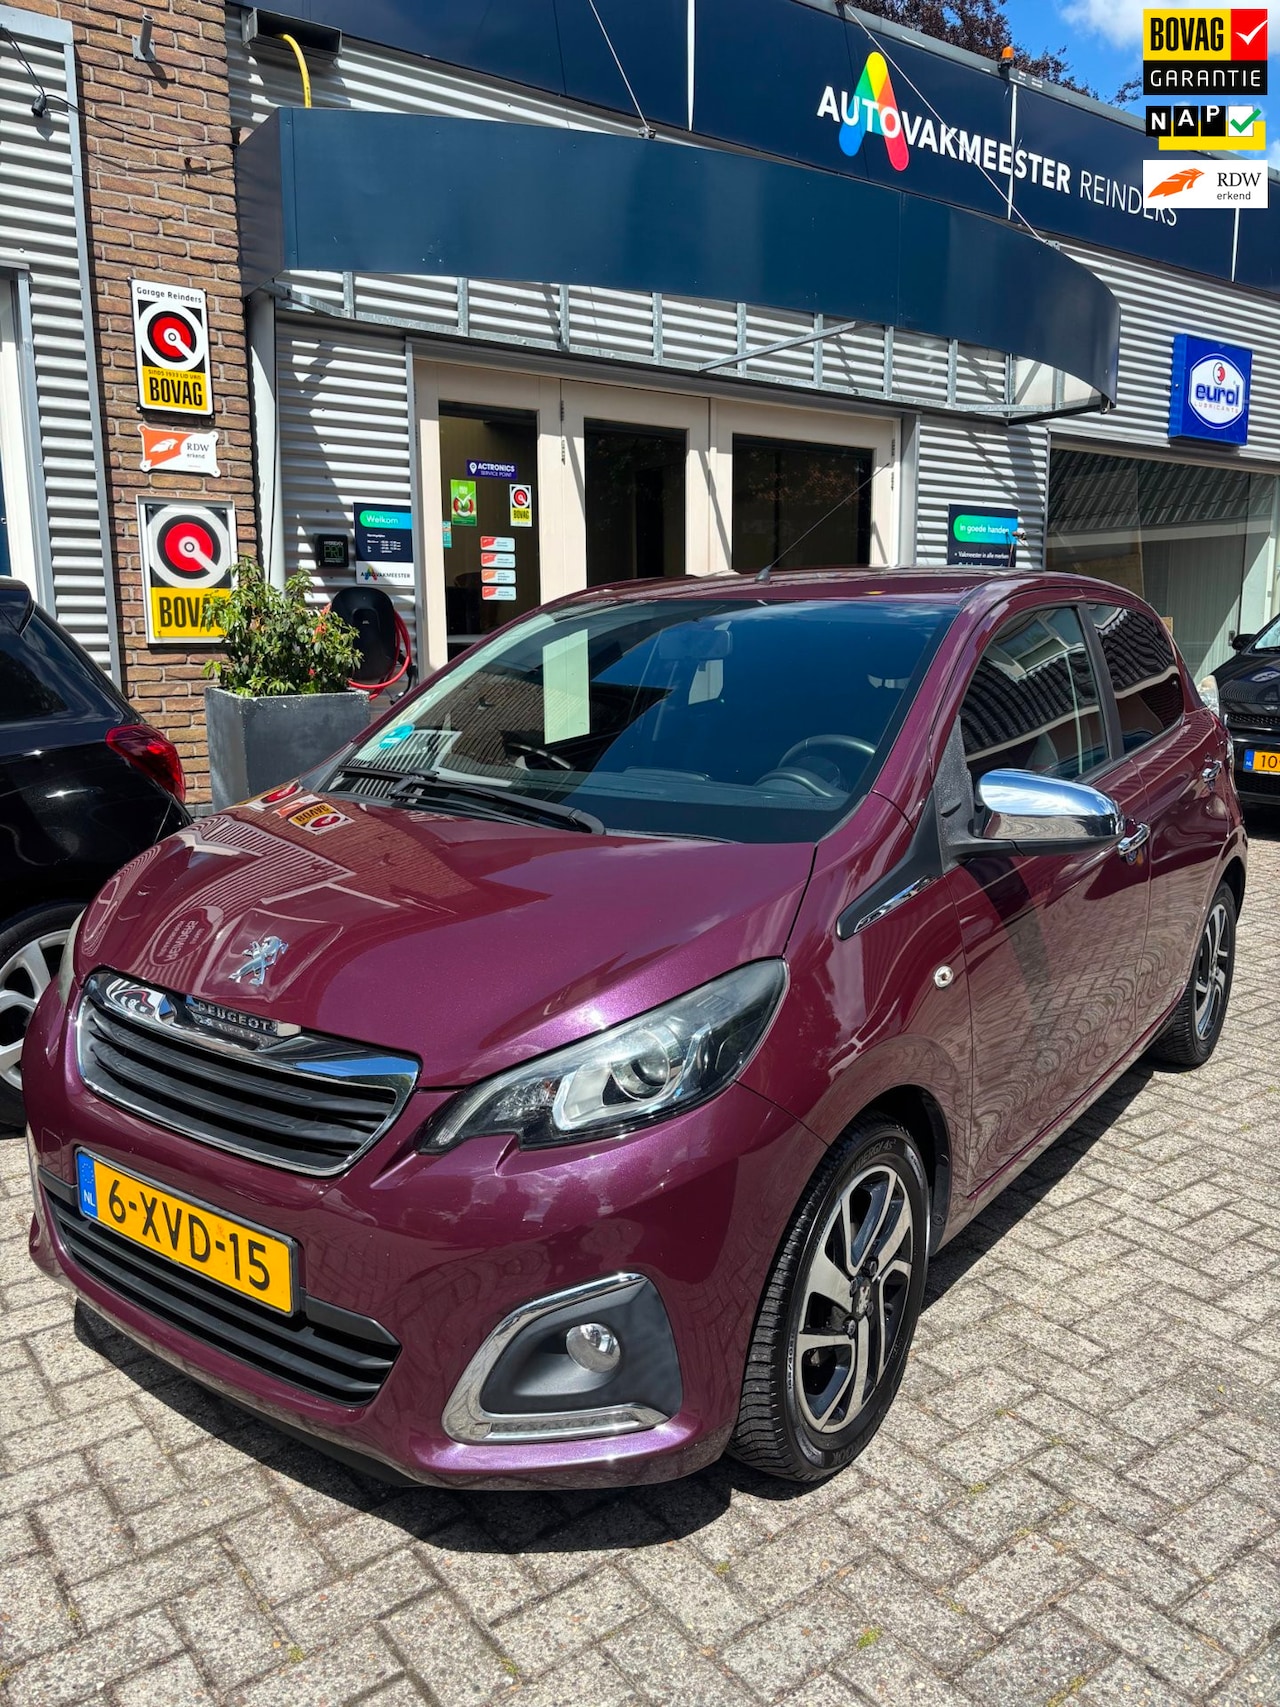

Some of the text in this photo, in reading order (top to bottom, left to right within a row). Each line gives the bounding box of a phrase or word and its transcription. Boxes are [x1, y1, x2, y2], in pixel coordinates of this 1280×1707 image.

[816, 85, 1071, 194] AUTOVAKMEESTER
[136, 286, 202, 303] Garage Reinders
[149, 376, 203, 407] BOVAG
[1195, 383, 1240, 407] eurol
[1194, 401, 1239, 414] LUBRICANTS
[186, 442, 210, 452] RDW
[477, 462, 515, 473] ACTRONICS
[366, 514, 399, 524] Welkom
[513, 509, 530, 520] BOVAG
[967, 524, 987, 534] goede
[987, 524, 1010, 534] handen
[198, 1001, 270, 1031] PEUGEOT
[83, 1188, 96, 1207] NL
[108, 1179, 270, 1291] 6-XVD-15
